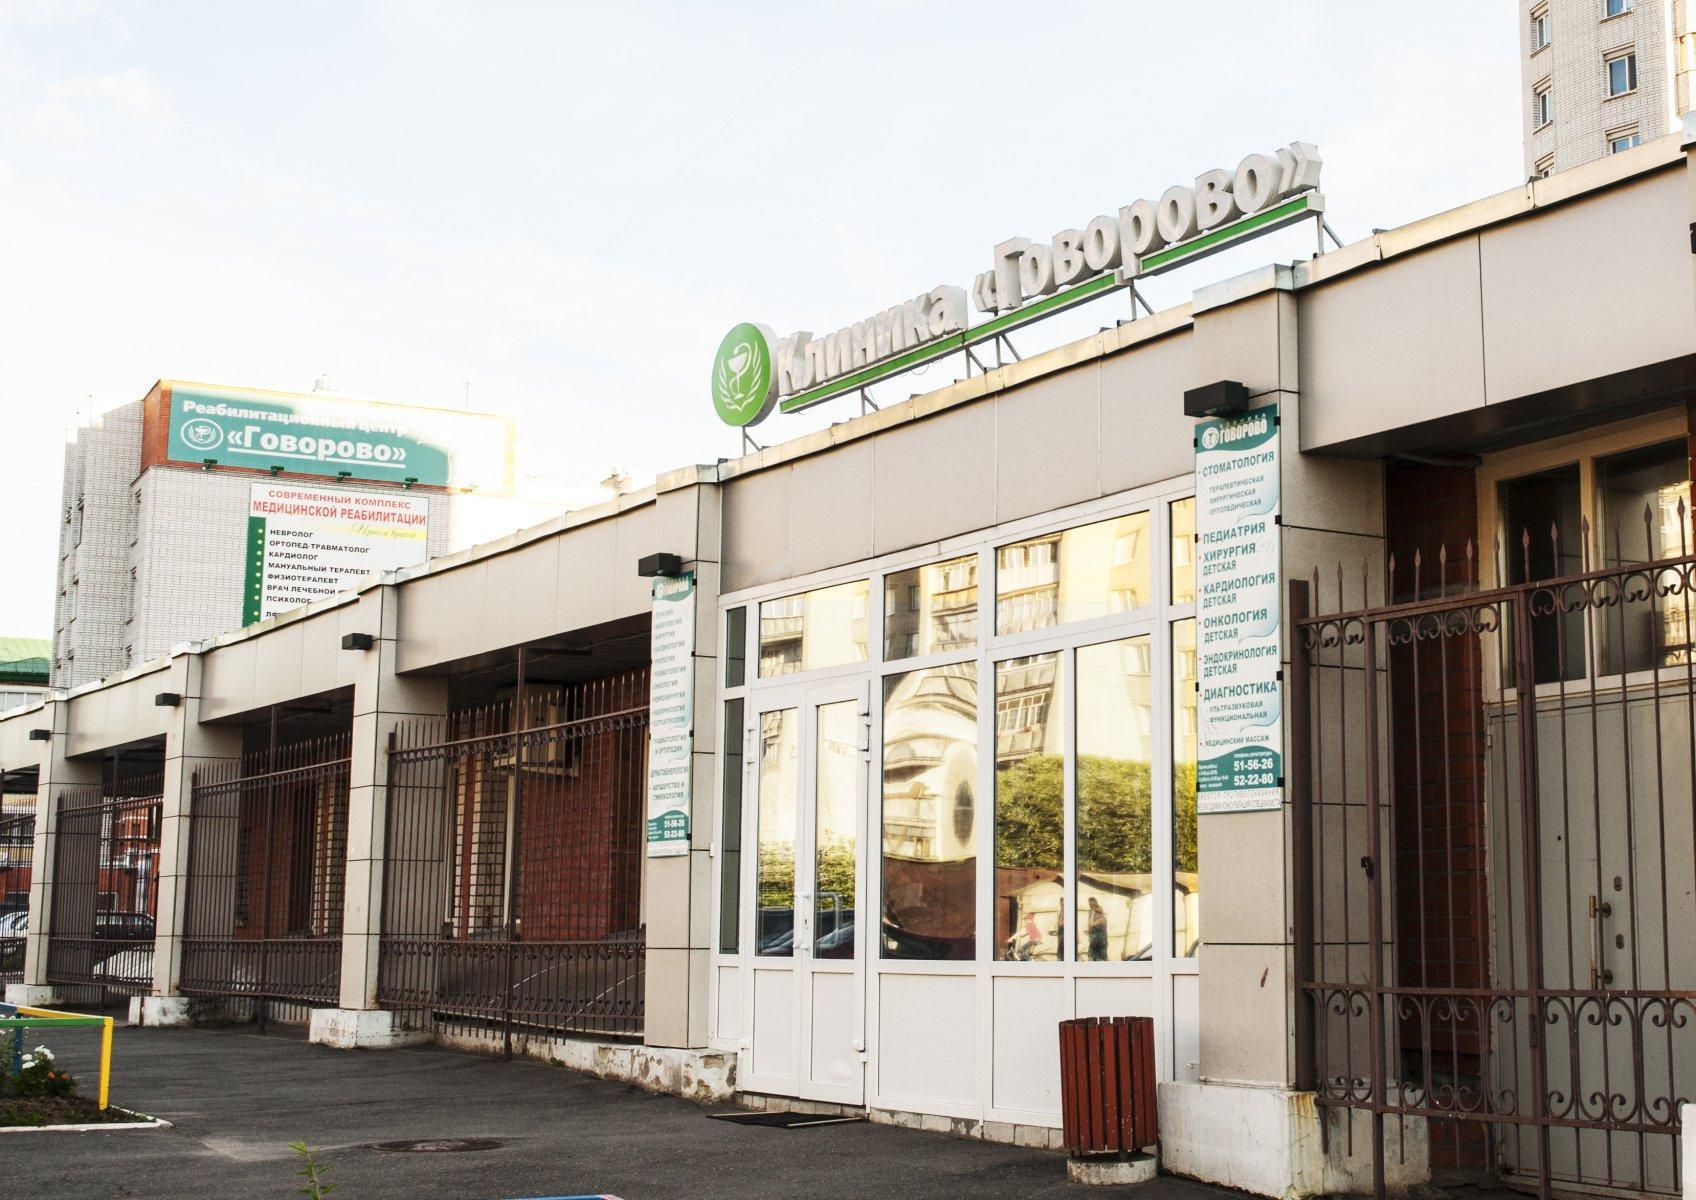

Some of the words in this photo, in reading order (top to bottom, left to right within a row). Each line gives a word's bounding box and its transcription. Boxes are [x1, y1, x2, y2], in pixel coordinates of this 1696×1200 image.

[777, 284, 969, 395] Клиника
[972, 141, 1323, 311] «Говорово»
[182, 400, 356, 430] Реабилитационный
[357, 421, 408, 437] центр
[1219, 419, 1268, 444] ГОВОРОВО
[227, 425, 407, 462] «Говорово»
[1202, 451, 1275, 478] СТОМАТОЛОГИЯ
[1209, 475, 1264, 493] ТЕРАПЕВТИЧЕСКАЯ
[268, 490, 351, 504] СОВРЕМЕННЫЙ
[354, 498, 411, 509] КОМПЛЕКС
[1209, 488, 1256, 504] ХИРУРГИЧЕСКАЯ
[252, 501, 337, 518] МЕДИЦИНСКОЙ
[341, 509, 426, 526] РЕАБИЛИТАЦИИ
[1209, 498, 1262, 516] ОРТОПЕДИЧЕСКАЯ
[270, 529, 314, 538] НЕВРОЛОГ
[1203, 521, 1266, 545] ПЕДИАТРИЯ
[269, 540, 370, 554] ОРТОПЕД-ТРАВМАТОЛОГ
[1203, 542, 1256, 563] ХИРУРГИЯ
[268, 552, 319, 560] КАРДИОЛОГ
[268, 562, 327, 573] МАНУАЛЬНЫЙ
[329, 567, 371, 576] ТЕРАПЕВТ
[1202, 560, 1237, 577] ДЕТСКАЯ
[267, 573, 340, 584] ФИЗИОТЕРАПЕВТ
[1203, 572, 1276, 595] КАРДИОЛОГИЯ
[266, 584, 289, 592] ВРАЧ
[290, 586, 336, 595] ЛЕЧЕБНОЙ
[266, 596, 312, 604] ПСИХОЛОГ
[1202, 593, 1237, 610] ДЕТСКАЯ
[1203, 608, 1268, 629] ОНКОЛОГИЯ
[1204, 628, 1239, 644] ДЕТСКАЯ
[1203, 645, 1277, 665] ЭНДОКРИНОЛОГИЯ
[1203, 663, 1238, 679] ДЕТСКАЯ
[1203, 680, 1278, 702] ДИАГНОСТИКА
[1209, 700, 1264, 713] УЛЬТРАЗВУКОВАЯ
[1209, 710, 1268, 724] ФУНКЦИОНАЛЬНАЯ
[1205, 736, 1244, 748] МЕДИЦИНСКИЙ
[1245, 735, 1270, 744] МАССАЖ
[1233, 757, 1274, 772] 51-56-26
[1233, 773, 1274, 786] 52-22-80
